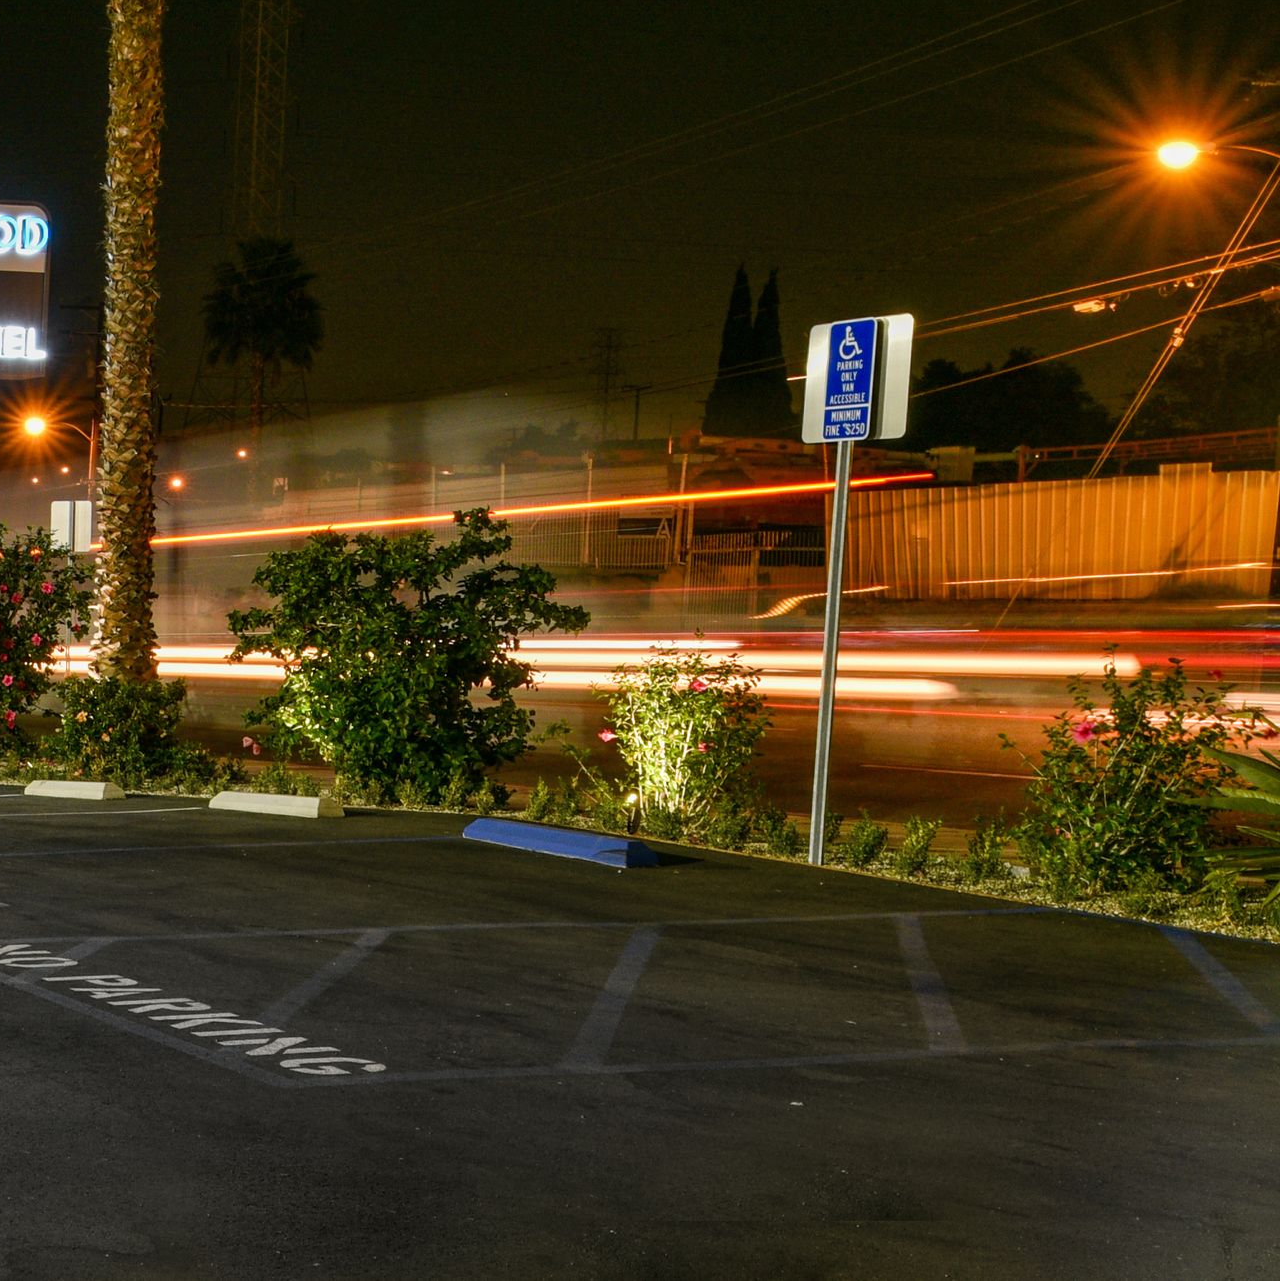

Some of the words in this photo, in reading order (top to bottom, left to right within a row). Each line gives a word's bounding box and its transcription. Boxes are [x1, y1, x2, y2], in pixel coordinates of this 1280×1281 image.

[836, 359, 864, 371] PARKING
[840, 371, 858, 382] ONLY
[842, 382, 855, 392] VAN
[829, 392, 866, 405] ACCESSIBLE
[830, 408, 862, 423] MINIMUM
[824, 424, 841, 436] FINE
[41, 973, 388, 1077] PARKING
